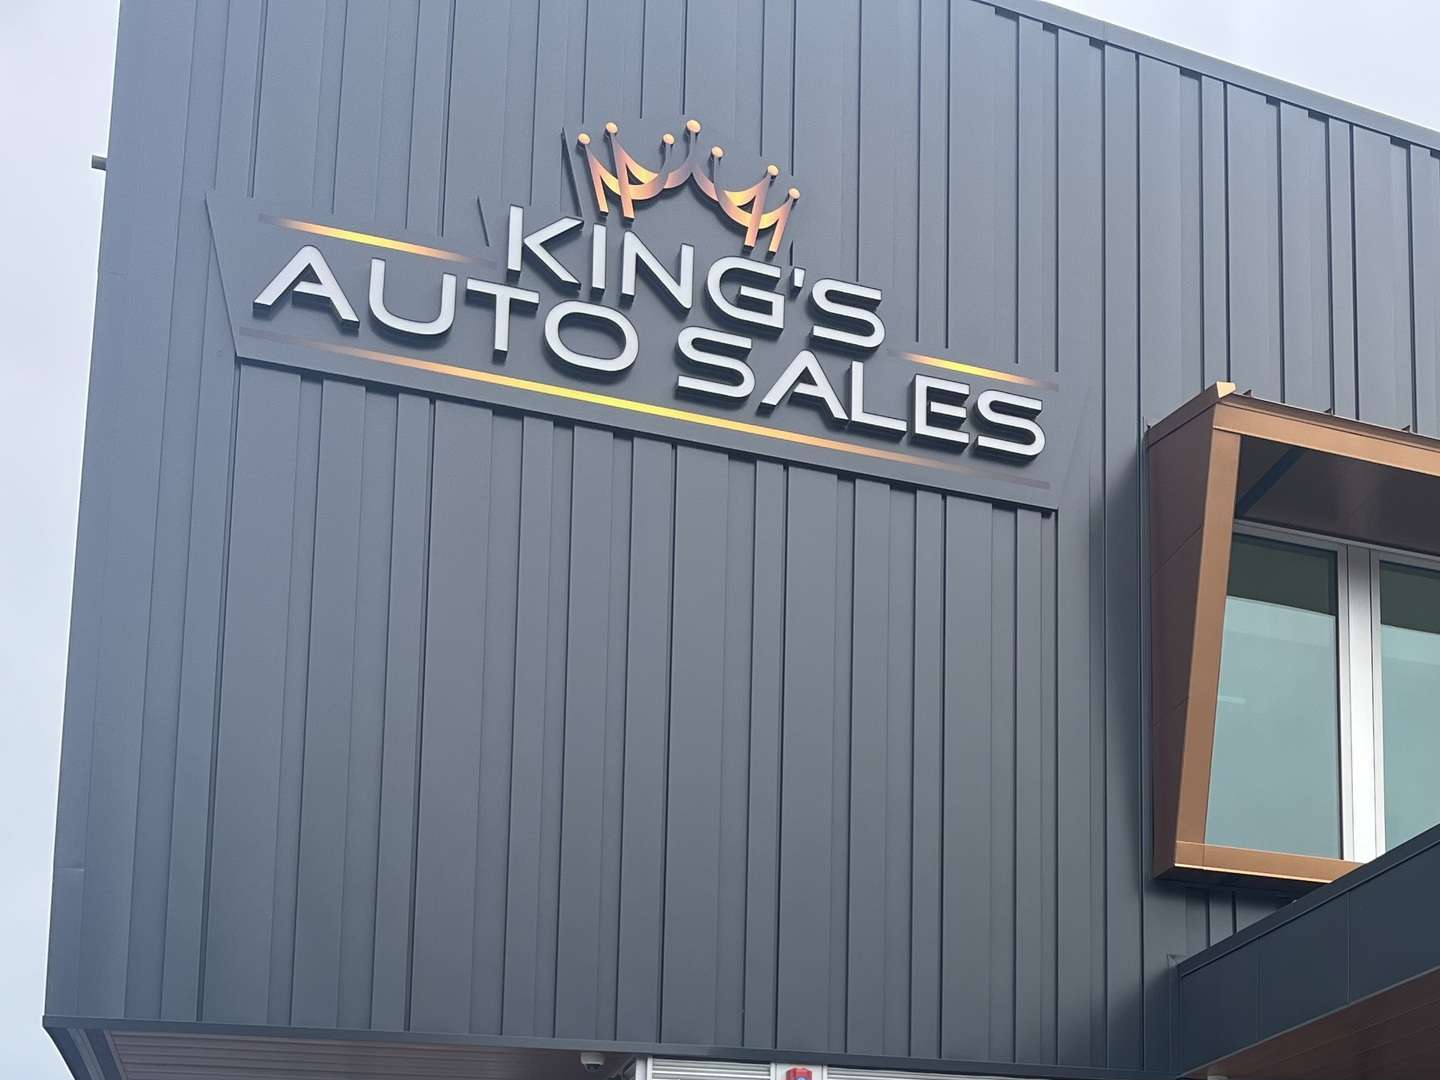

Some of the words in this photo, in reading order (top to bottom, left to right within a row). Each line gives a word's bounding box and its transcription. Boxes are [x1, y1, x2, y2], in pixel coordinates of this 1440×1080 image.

[252, 244, 640, 376] AUTO
[675, 325, 1047, 463] SALES
[507, 204, 886, 354] KING'S
